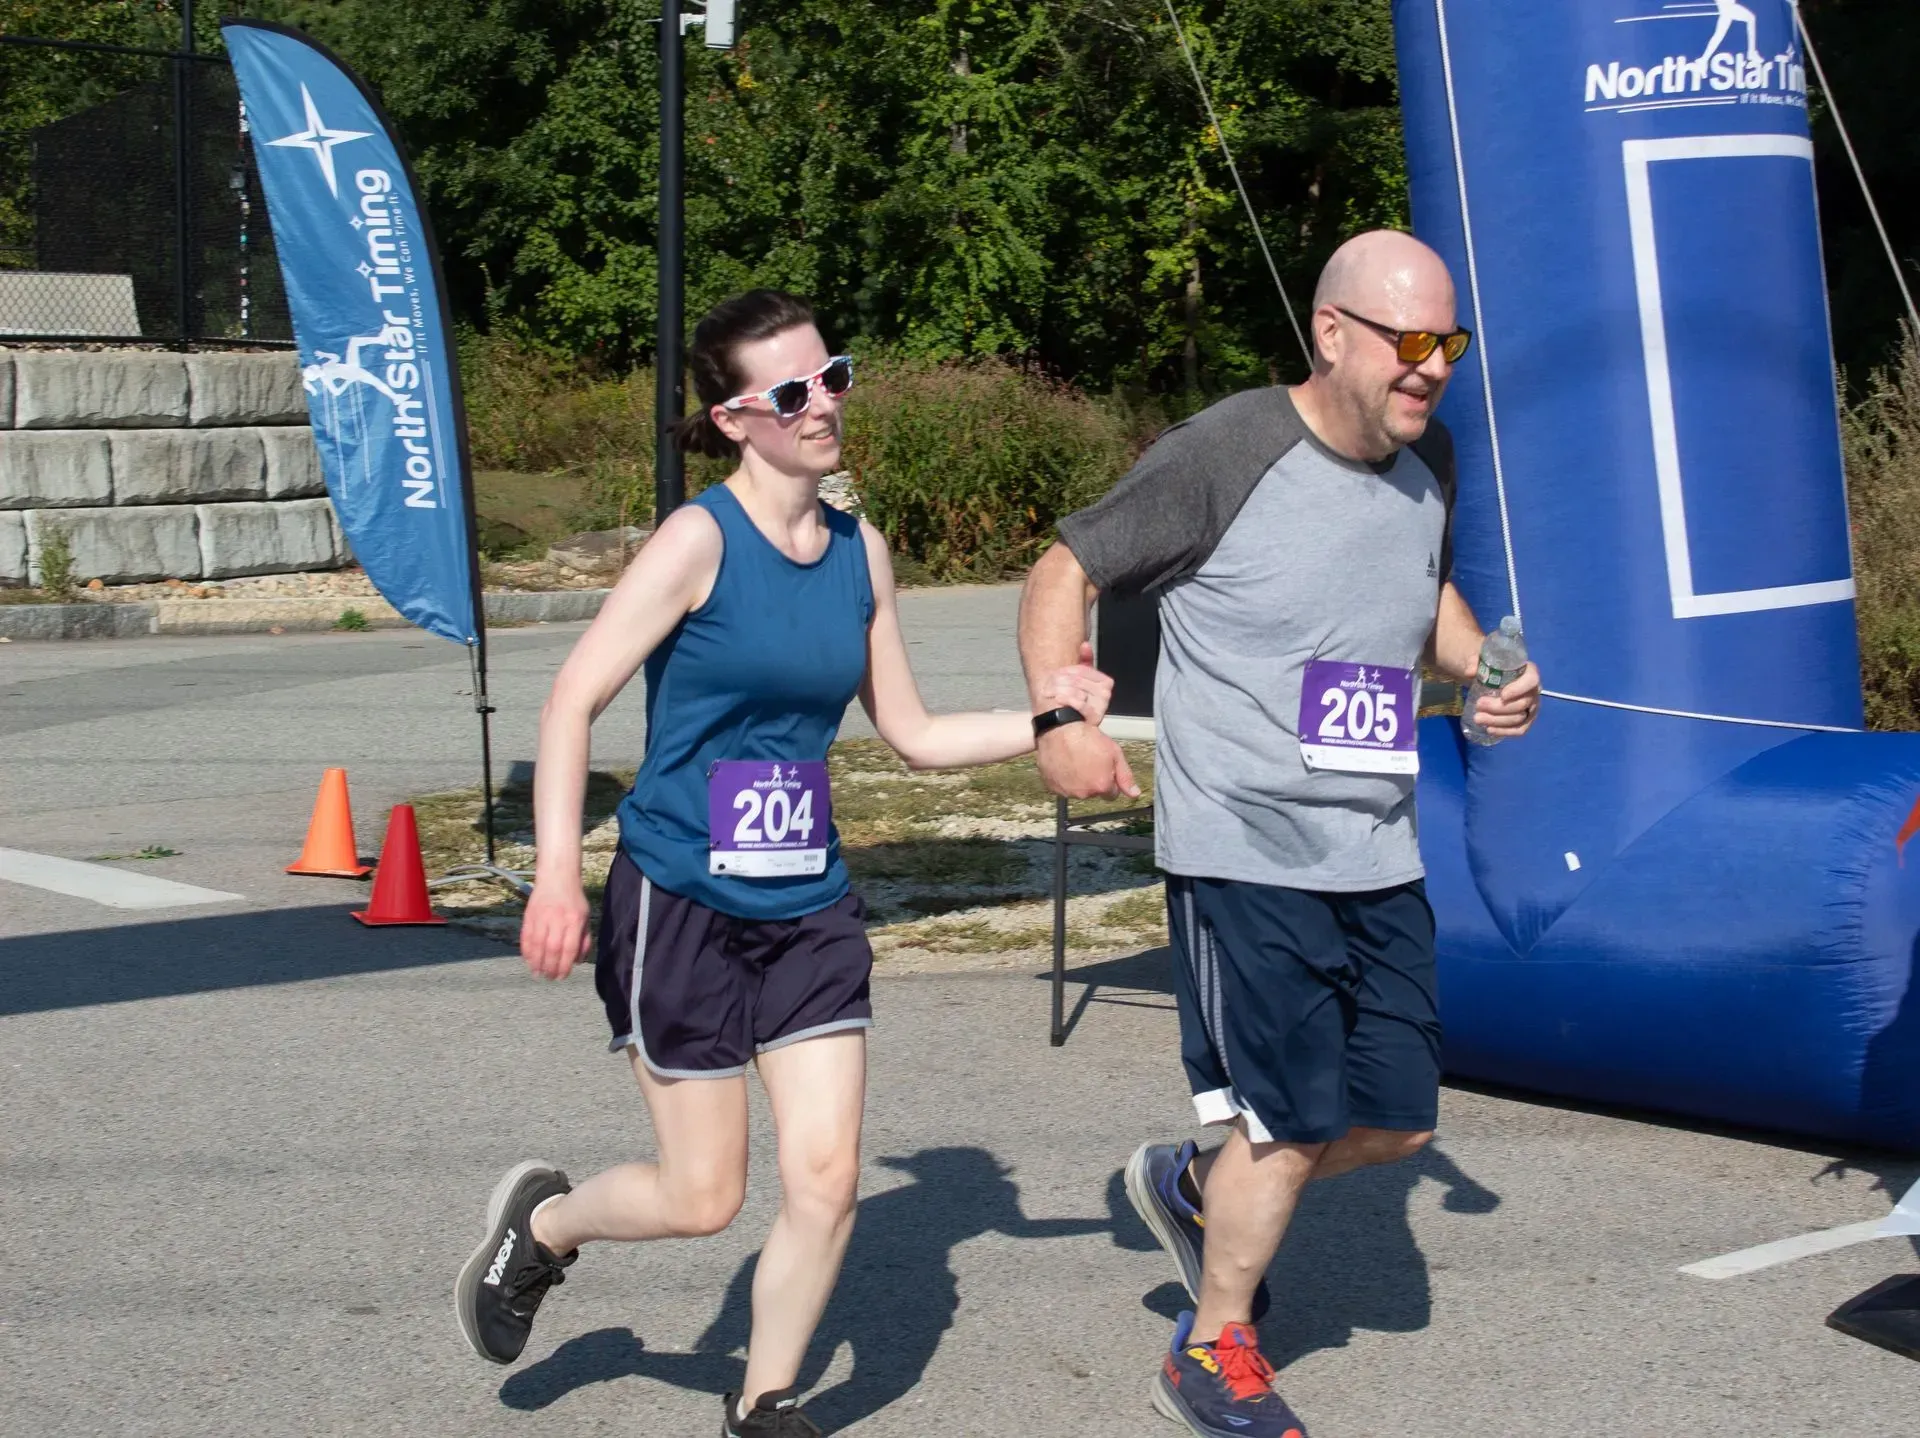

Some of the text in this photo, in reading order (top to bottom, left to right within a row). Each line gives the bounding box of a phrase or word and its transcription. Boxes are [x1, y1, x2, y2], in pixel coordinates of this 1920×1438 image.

[1584, 55, 1702, 102] North
[1709, 51, 1774, 91] Star
[393, 208, 407, 237] Time
[400, 240, 412, 263] Can
[404, 267, 416, 284] We
[410, 288, 424, 328] Moves,
[350, 169, 437, 509] North Star Timing
[414, 332, 427, 341] It
[416, 344, 429, 353] If
[1318, 688, 1398, 743] 205
[733, 789, 814, 842] 204
[484, 1228, 517, 1286] HOKA
